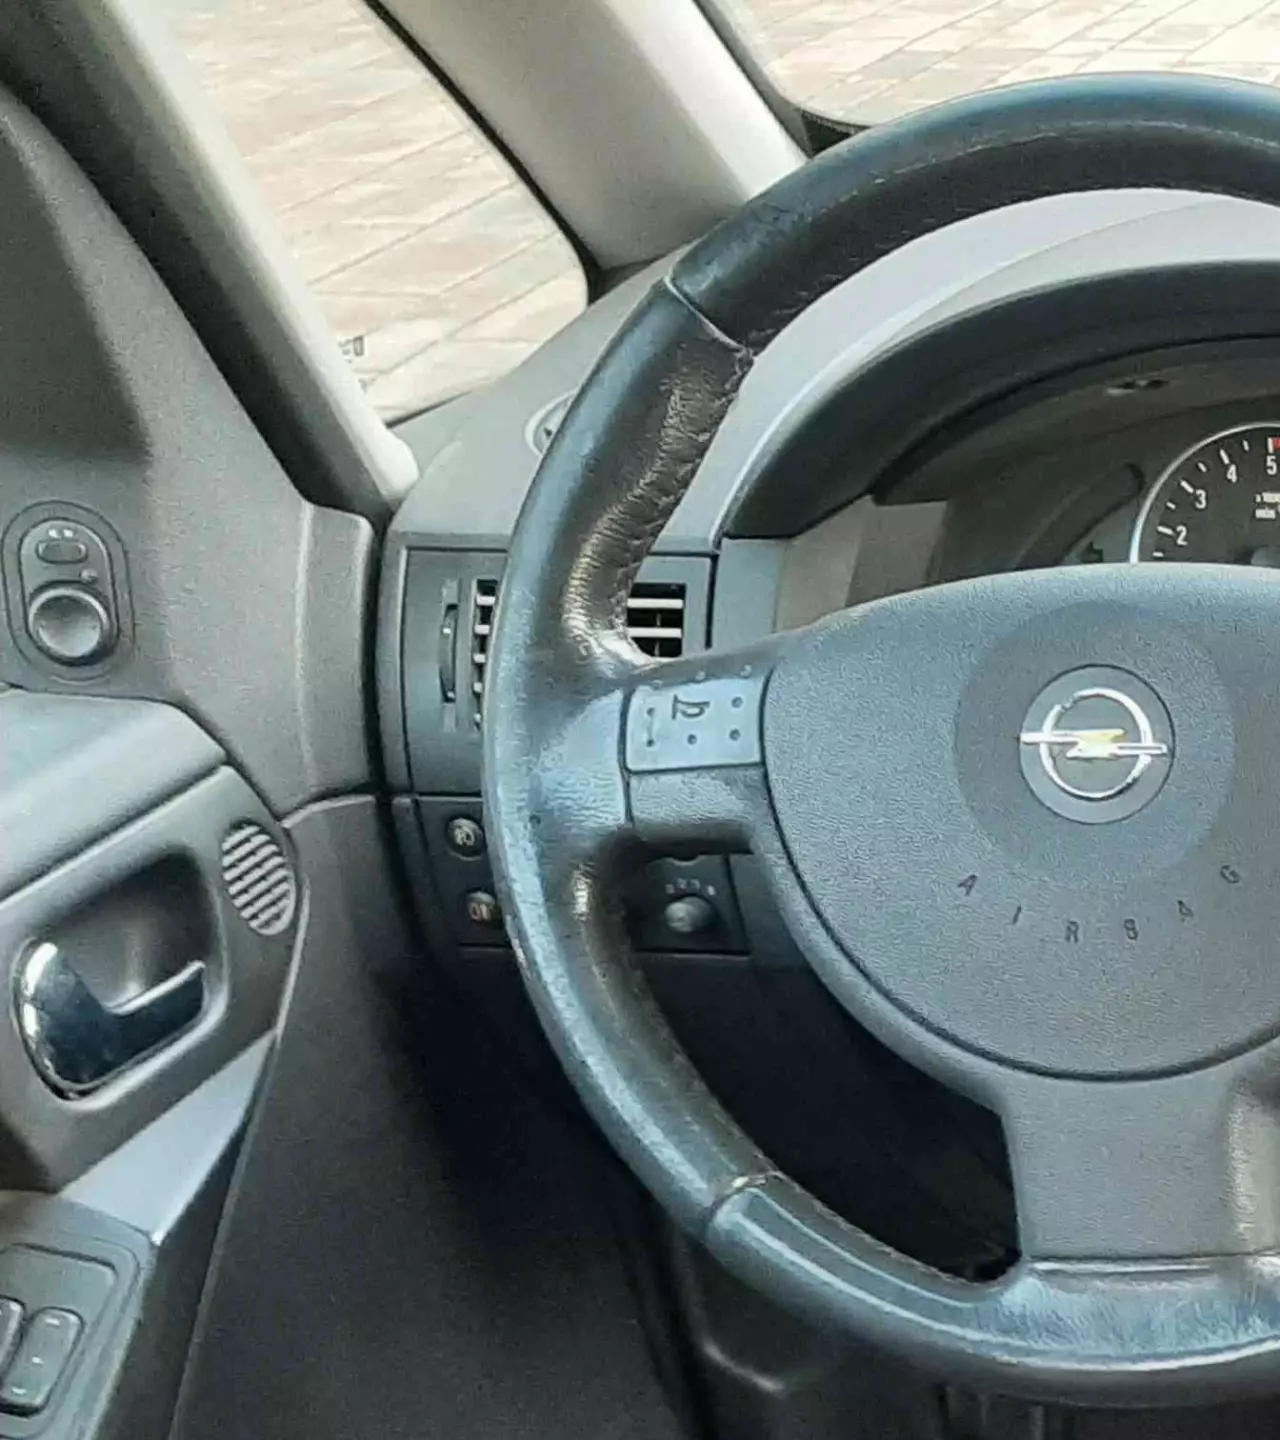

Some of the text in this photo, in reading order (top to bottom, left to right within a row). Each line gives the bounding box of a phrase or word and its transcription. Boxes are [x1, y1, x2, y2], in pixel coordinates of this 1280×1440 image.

[1226, 464, 1238, 483] 4
[1266, 455, 1277, 475] 5
[1195, 489, 1207, 509] 3
[1176, 525, 1188, 546] 2
